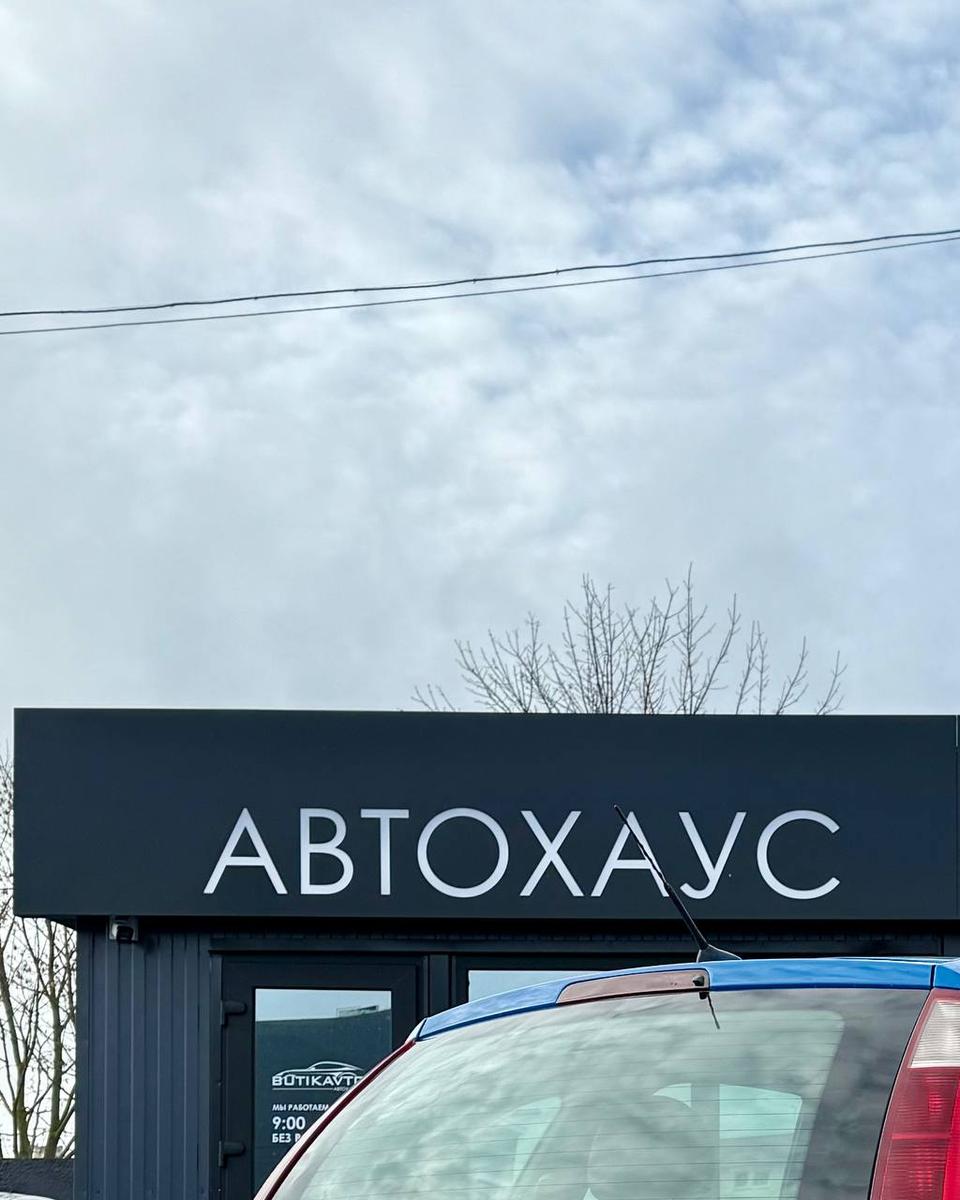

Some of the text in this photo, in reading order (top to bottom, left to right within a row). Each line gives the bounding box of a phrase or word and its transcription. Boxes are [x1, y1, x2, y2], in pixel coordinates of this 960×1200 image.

[204, 807, 841, 899] АВТОХАУС
[272, 1116, 306, 1130] 9:00
[272, 1133, 291, 1143] БЕЗ
